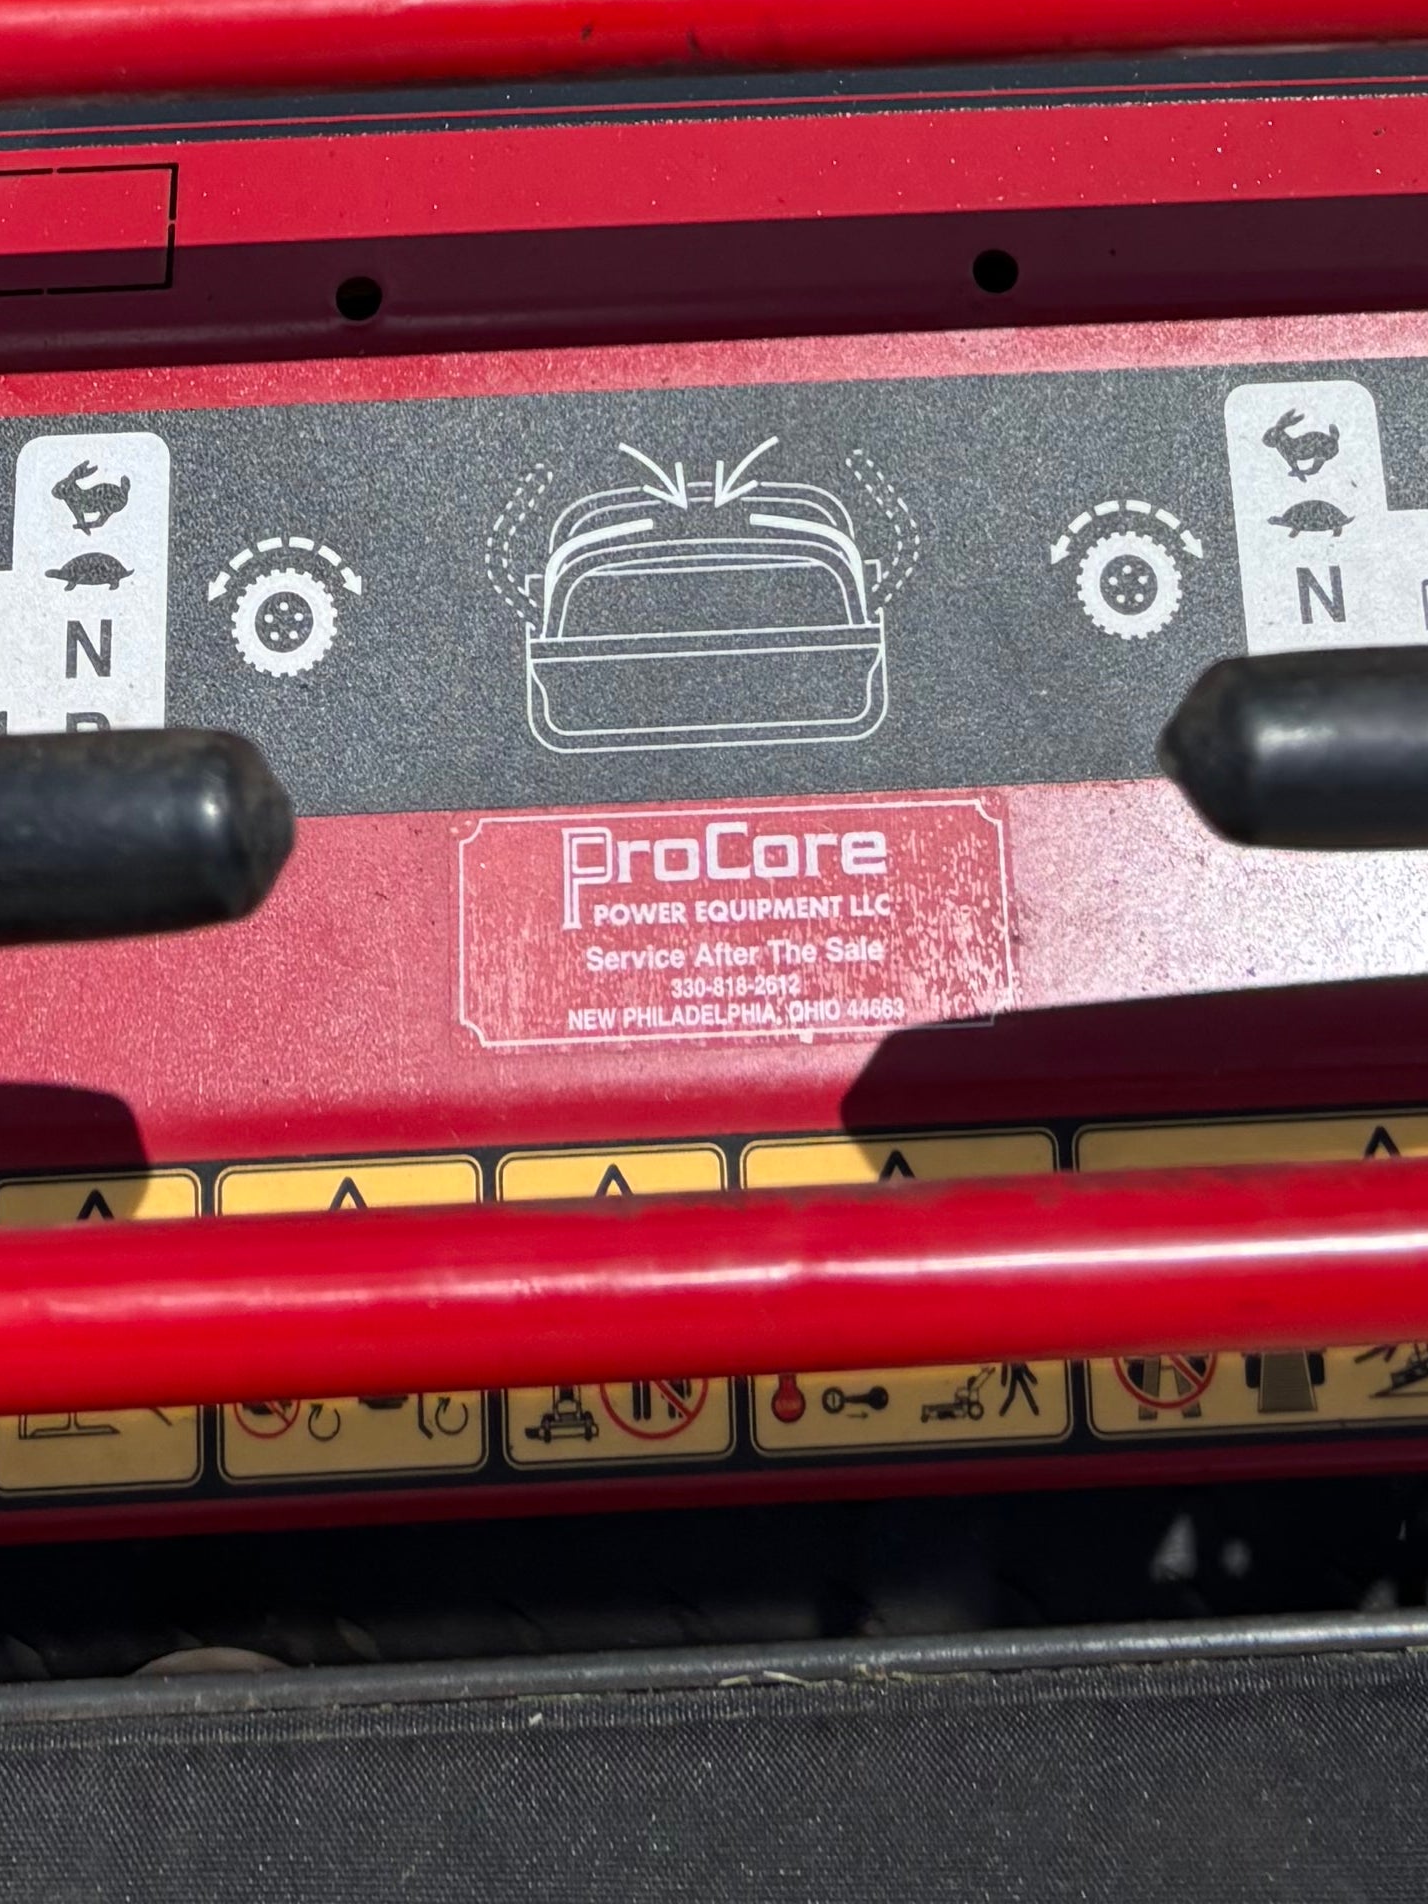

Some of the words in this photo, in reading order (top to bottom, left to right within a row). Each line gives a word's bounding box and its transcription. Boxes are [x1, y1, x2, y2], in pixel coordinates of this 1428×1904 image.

[1295, 564, 1347, 625] N
[65, 618, 113, 679] N
[561, 821, 888, 930] ProCore
[593, 901, 686, 927] POWER
[694, 896, 841, 923] EQUIPMENT
[847, 894, 892, 918] LLC
[585, 944, 685, 972] Service
[693, 942, 760, 968] After
[766, 939, 819, 965] The
[824, 936, 884, 963] Sale
[671, 973, 801, 999] 330-818-2612
[568, 1007, 617, 1032] NEW
[788, 999, 842, 1024] OHIO
[846, 996, 905, 1021] 44663
